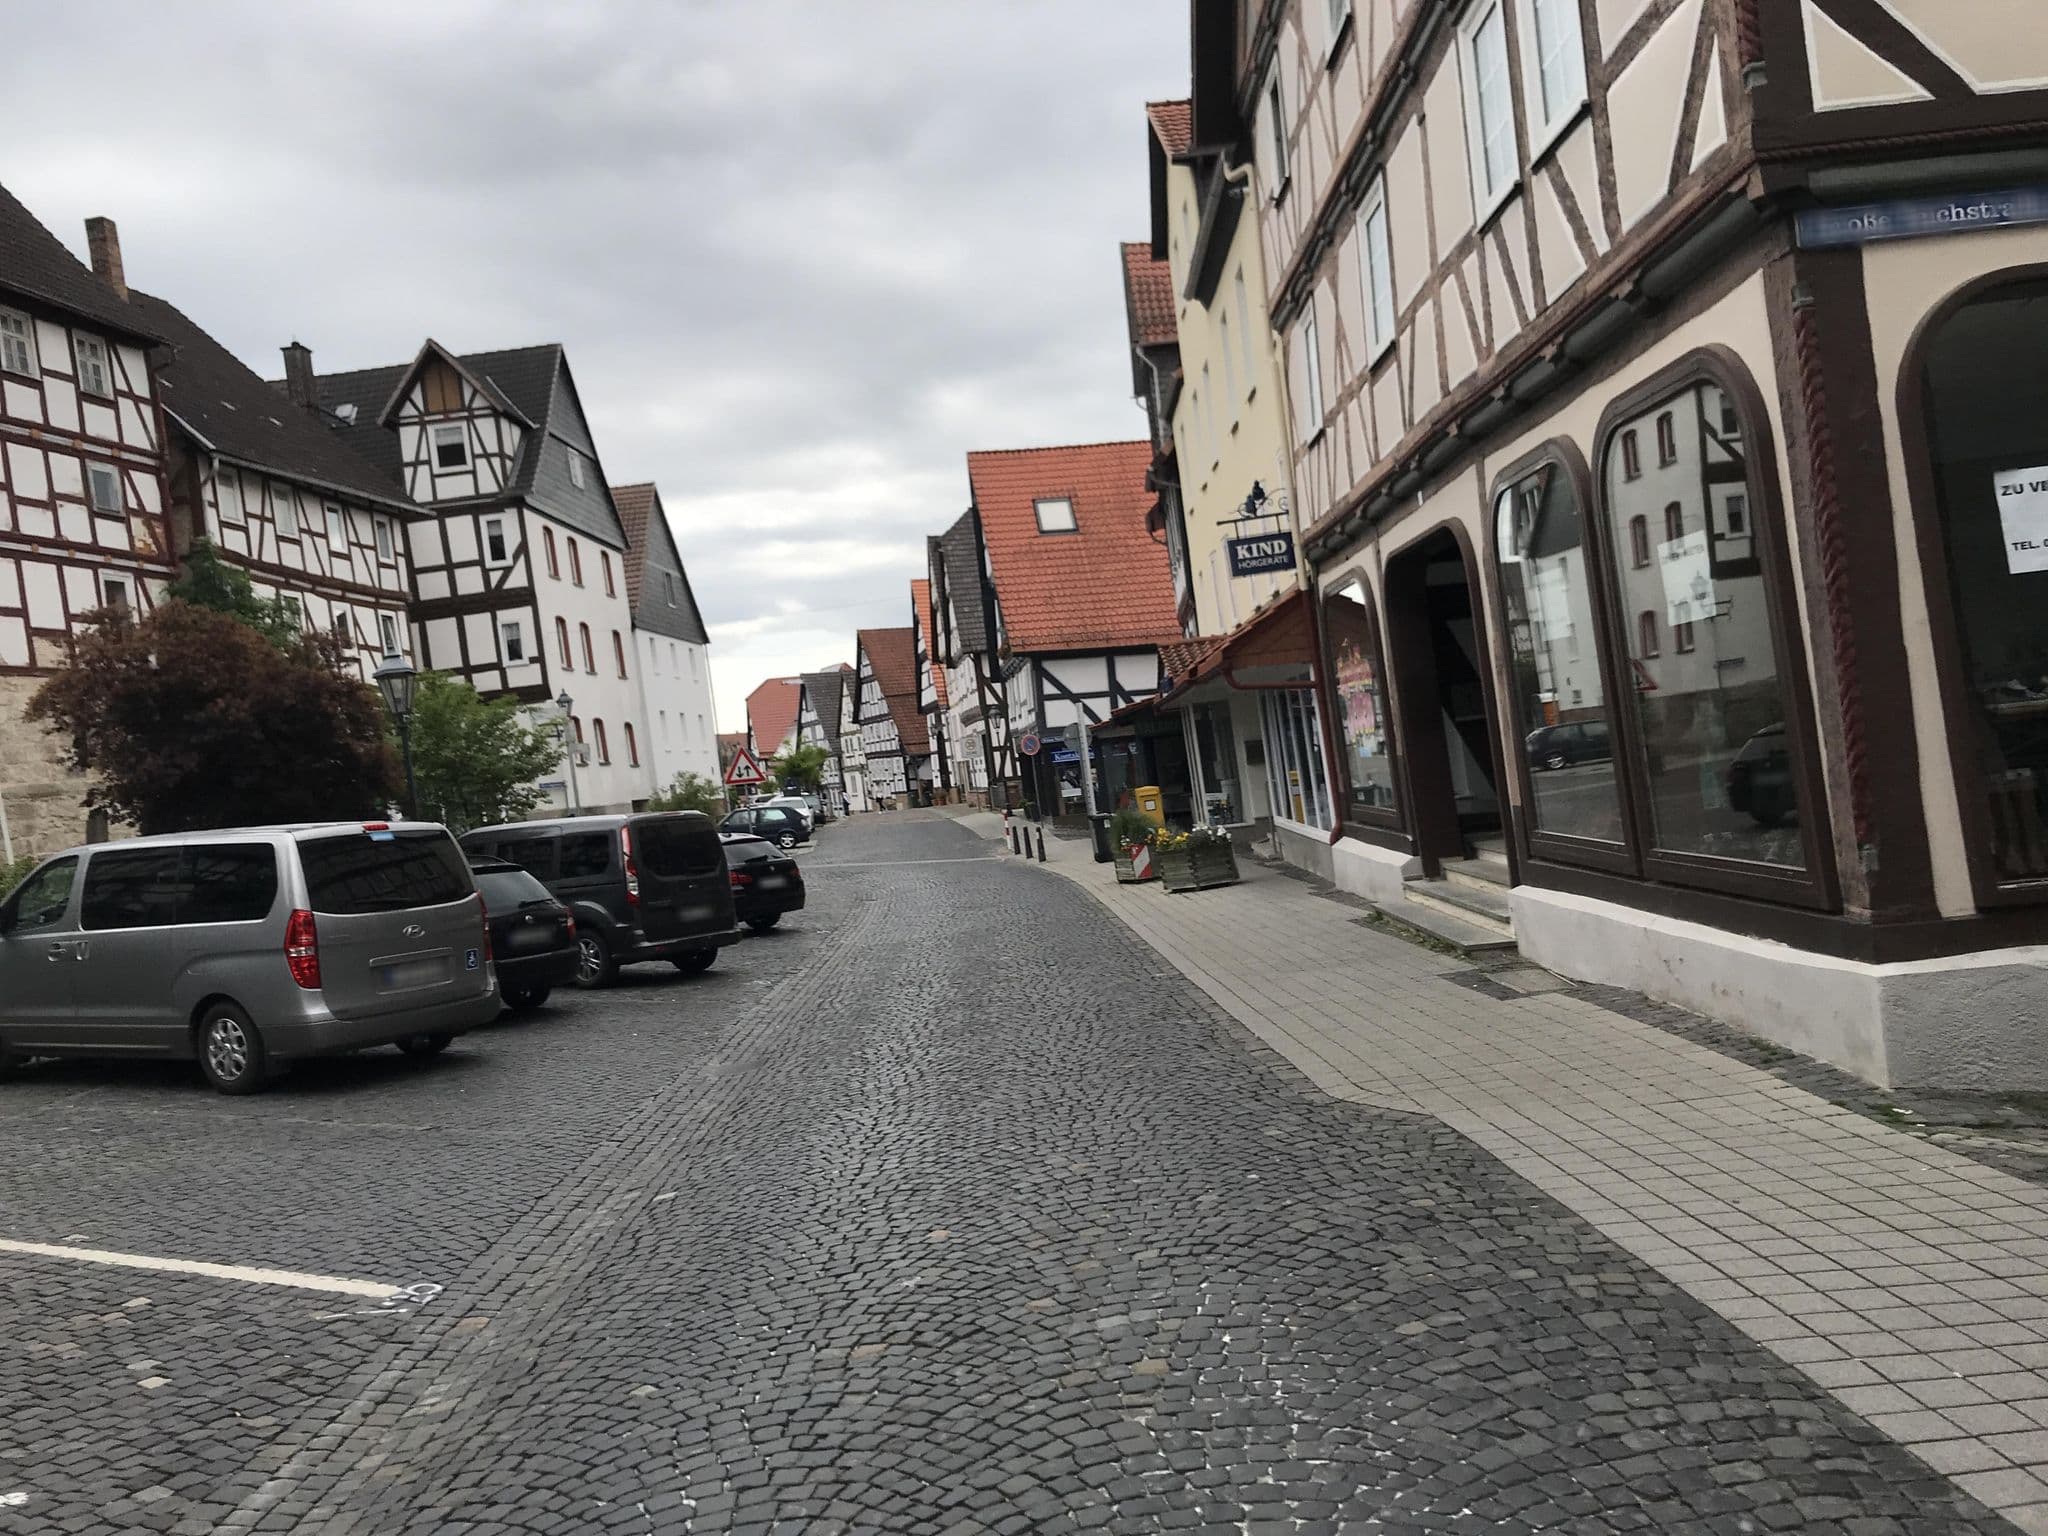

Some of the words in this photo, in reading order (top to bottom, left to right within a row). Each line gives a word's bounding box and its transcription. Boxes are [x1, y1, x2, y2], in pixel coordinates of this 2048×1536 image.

[2001, 483, 2024, 496] ZU
[1235, 540, 1287, 559] KIND
[2011, 541, 2040, 551] TEL.
